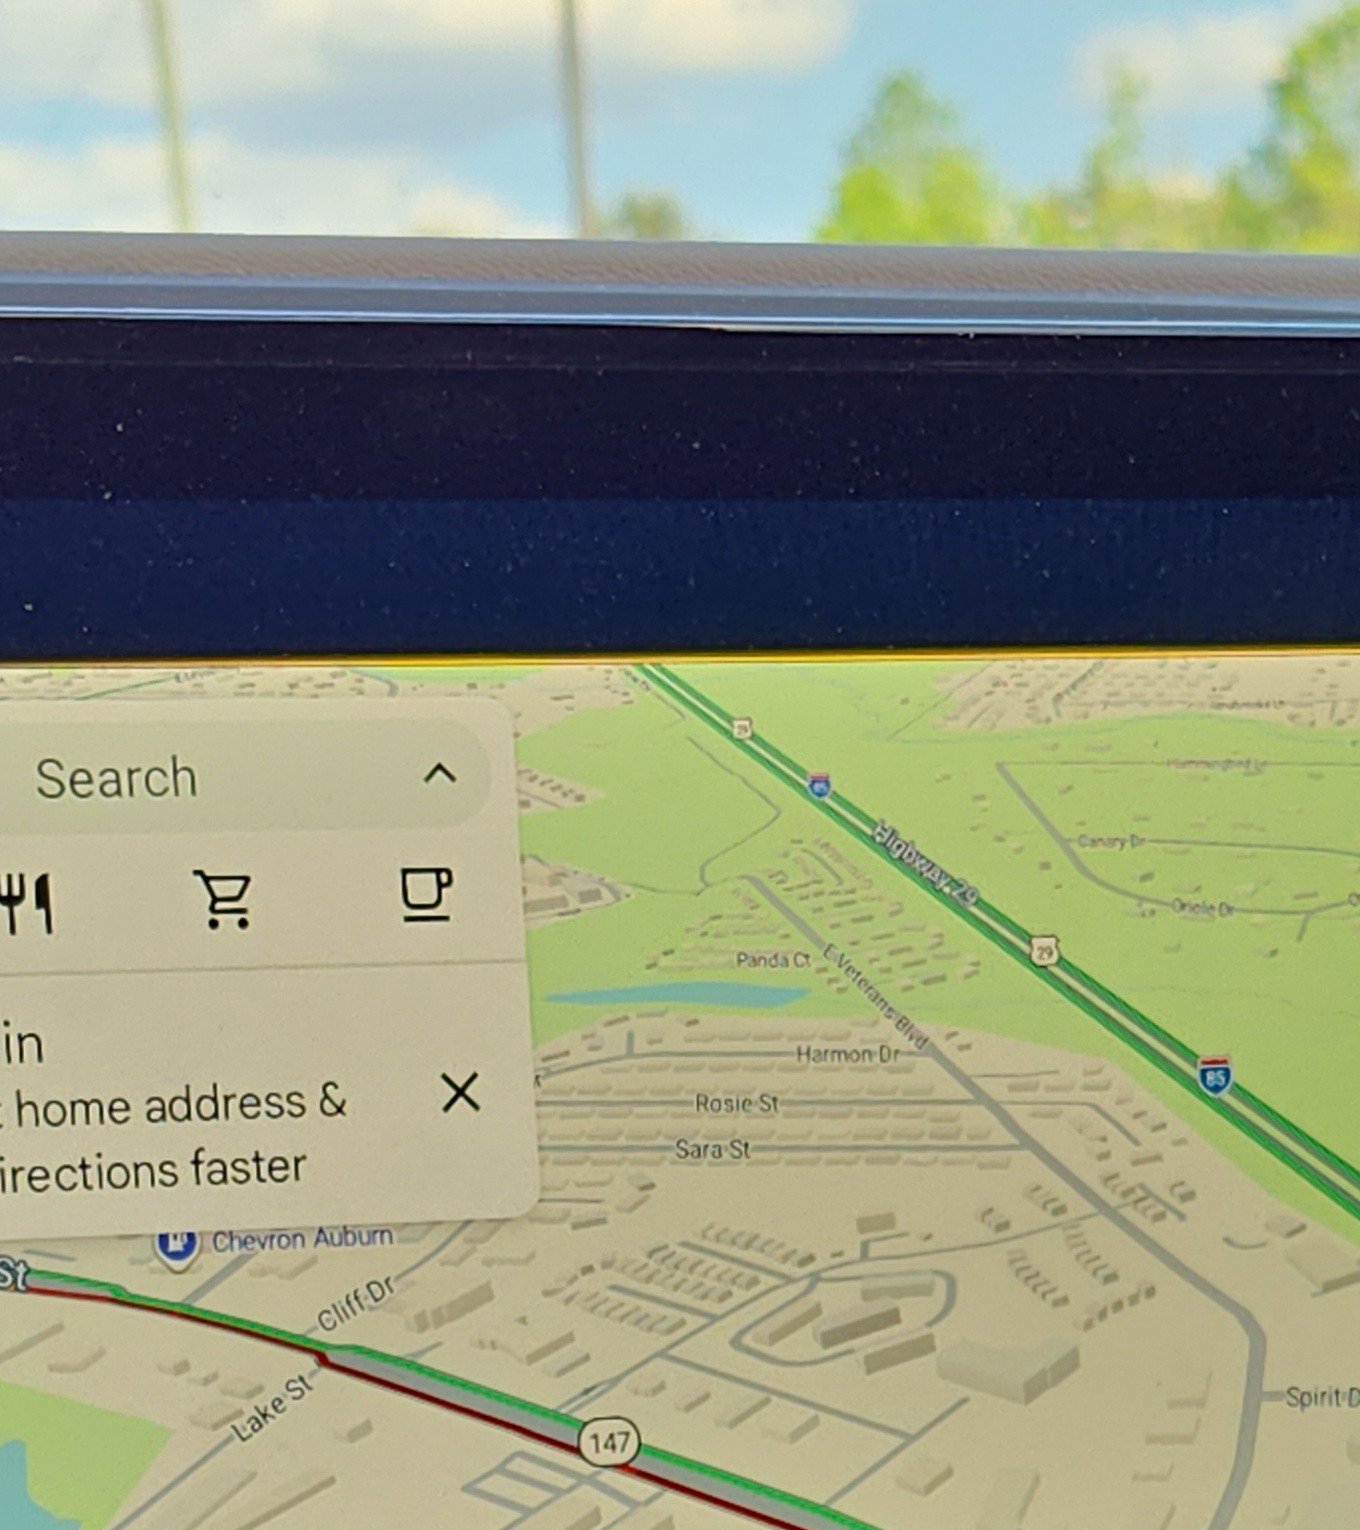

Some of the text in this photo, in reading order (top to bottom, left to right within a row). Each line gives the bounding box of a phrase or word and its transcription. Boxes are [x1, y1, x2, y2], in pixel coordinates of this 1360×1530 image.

[37, 754, 197, 800] Search
[873, 820, 980, 905] Highway 29
[736, 951, 811, 968] Panda Ct
[1037, 946, 1054, 960] 29
[824, 943, 930, 1050] E Veterans Blvd
[3, 1020, 44, 1064] in
[796, 1045, 901, 1063] Harmon Dr
[1206, 1070, 1226, 1087] 85
[16, 1089, 131, 1127] home
[145, 1083, 307, 1123] address
[319, 1081, 348, 1117] &
[695, 1094, 779, 1113] Rosie St
[675, 1139, 751, 1160] Sara St
[190, 1147, 307, 1186] faster
[212, 1225, 394, 1252] Chevron Auburn
[317, 1276, 396, 1332] Cliff Dr
[230, 1374, 314, 1443] Lake St
[1286, 1386, 1342, 1413] Spirit
[590, 1431, 630, 1454] 147
